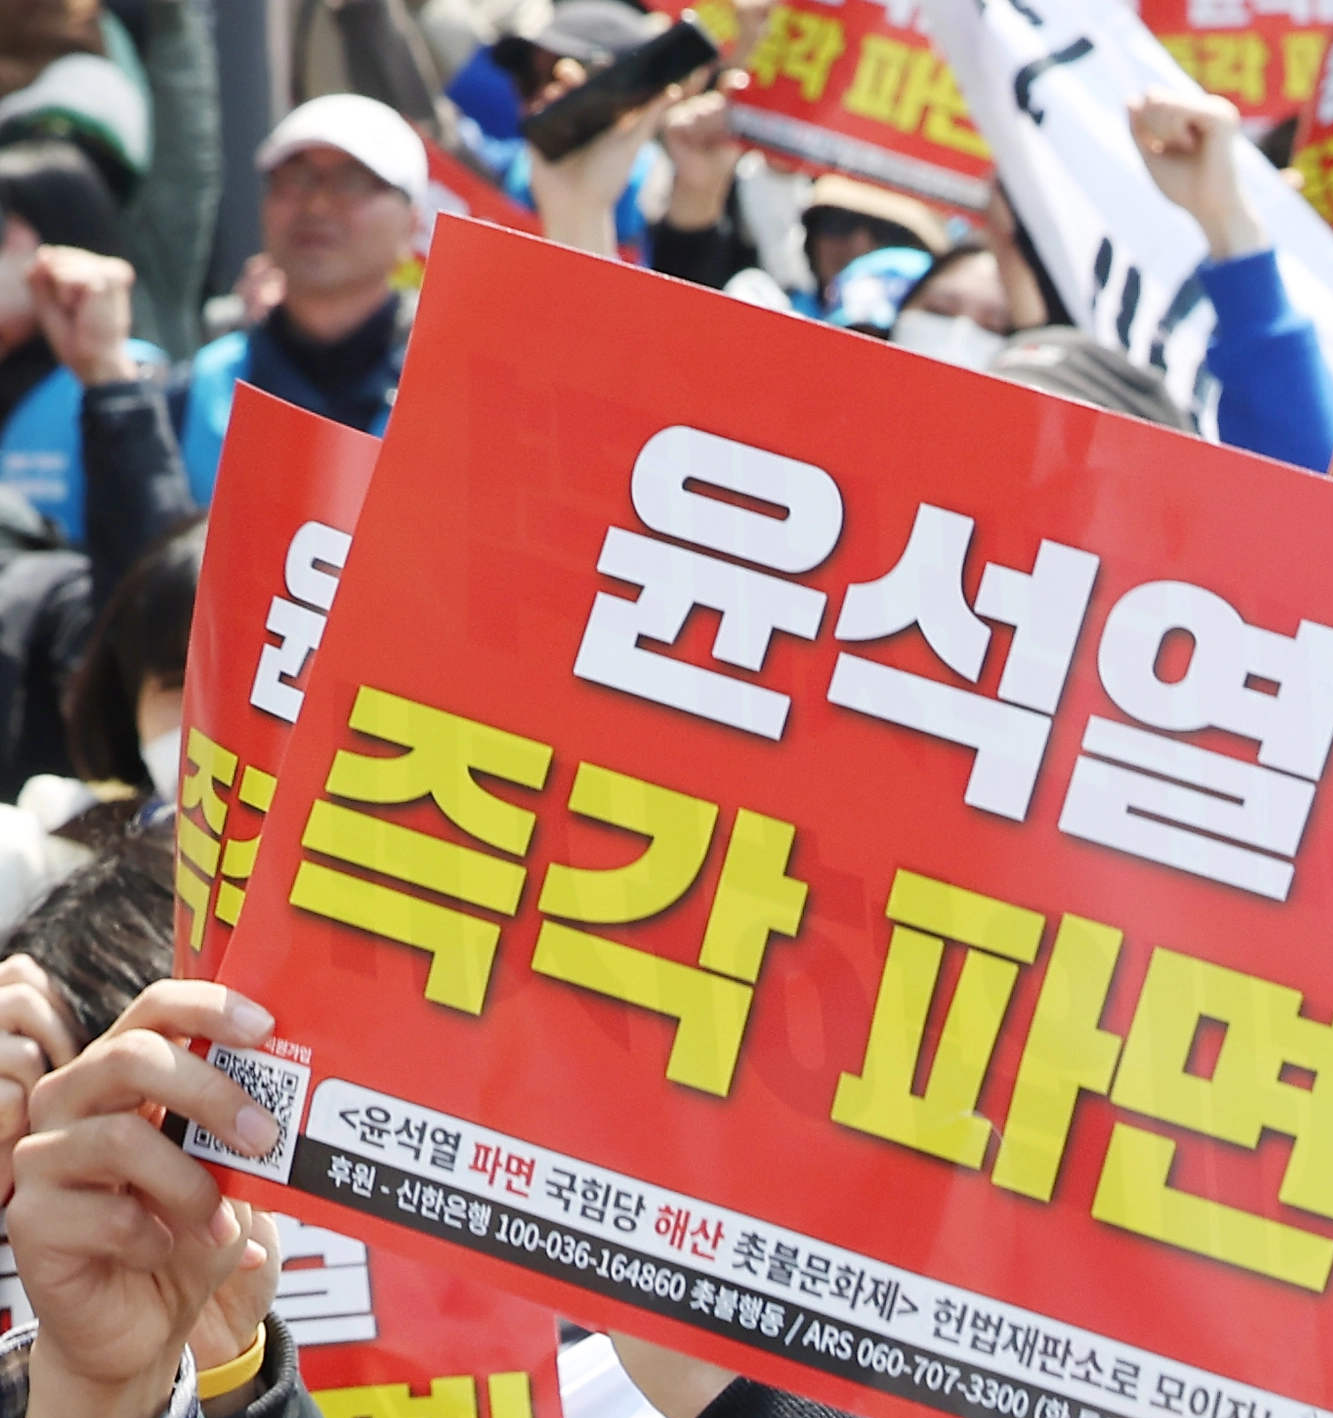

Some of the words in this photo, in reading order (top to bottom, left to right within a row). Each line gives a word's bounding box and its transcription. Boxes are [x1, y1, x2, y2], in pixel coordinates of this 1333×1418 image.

[289, 684, 809, 1098] 즉각
[326, 1153, 377, 1199] 후원
[396, 1180, 493, 1238] 신한은행
[494, 1213, 687, 1302] 100-036-164860
[689, 1278, 786, 1339] 촛불행동
[803, 1319, 855, 1361] ARS
[338, 1104, 462, 1172] <윤석열
[468, 1141, 536, 1198] 파면
[545, 1166, 646, 1233] 국힘당
[654, 1204, 725, 1262] 해산
[731, 1230, 919, 1323] 촛불문화제>
[932, 1295, 1142, 1400] 헌법재판소로
